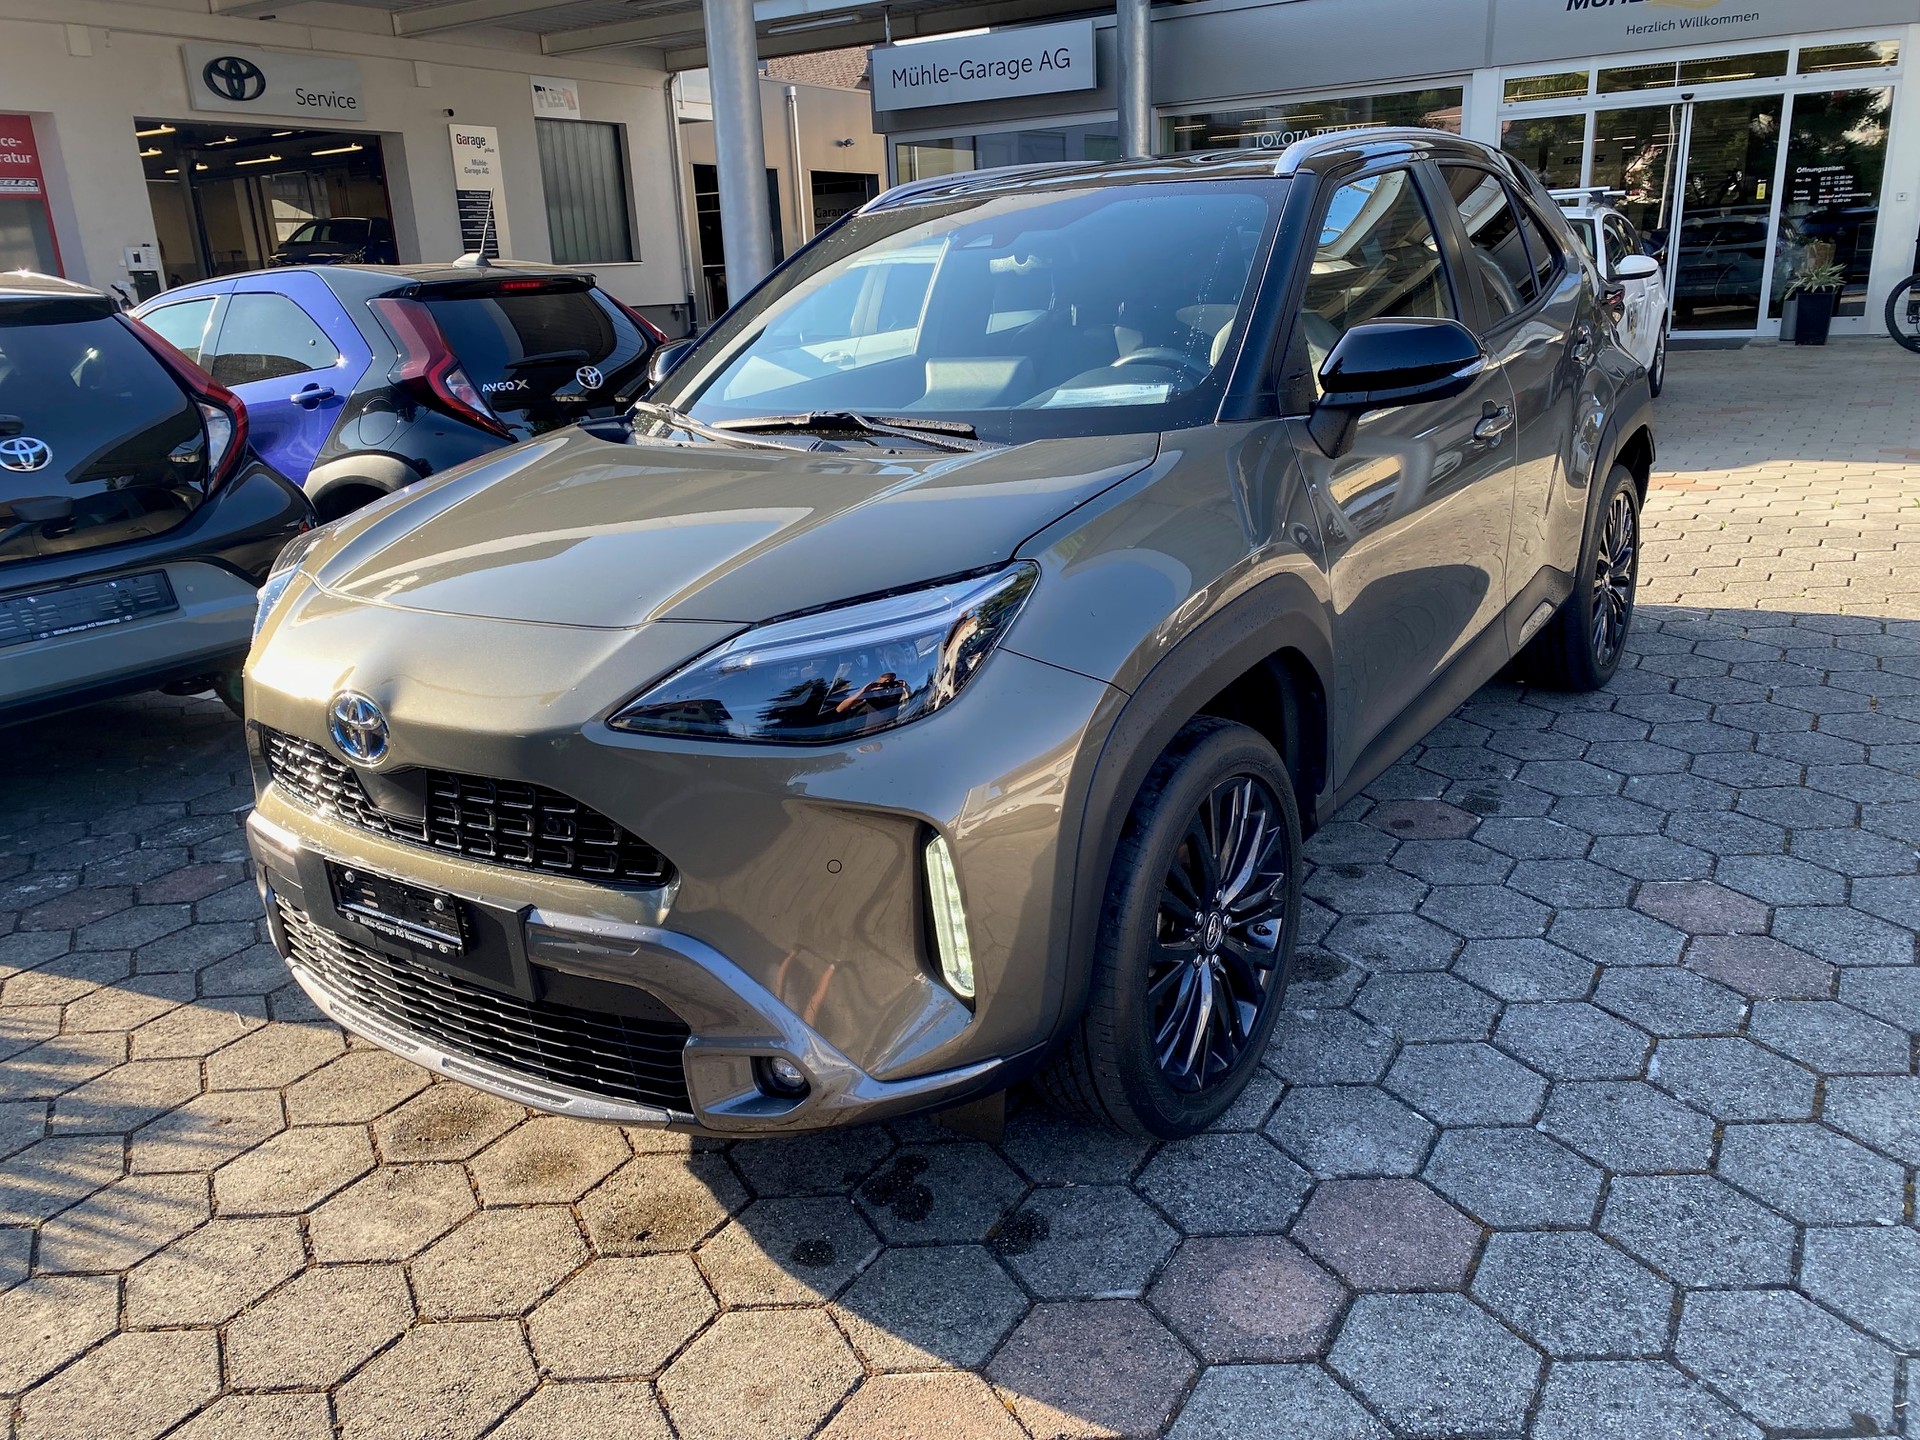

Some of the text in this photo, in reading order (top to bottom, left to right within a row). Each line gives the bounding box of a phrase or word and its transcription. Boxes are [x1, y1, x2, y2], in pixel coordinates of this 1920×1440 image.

[1626, 12, 1760, 36] Herzlich Willkommen
[892, 47, 1071, 89] Mühle-Garage AG
[295, 87, 357, 110] Service
[456, 134, 486, 148] Garage
[1253, 129, 1311, 149] TOYOTA
